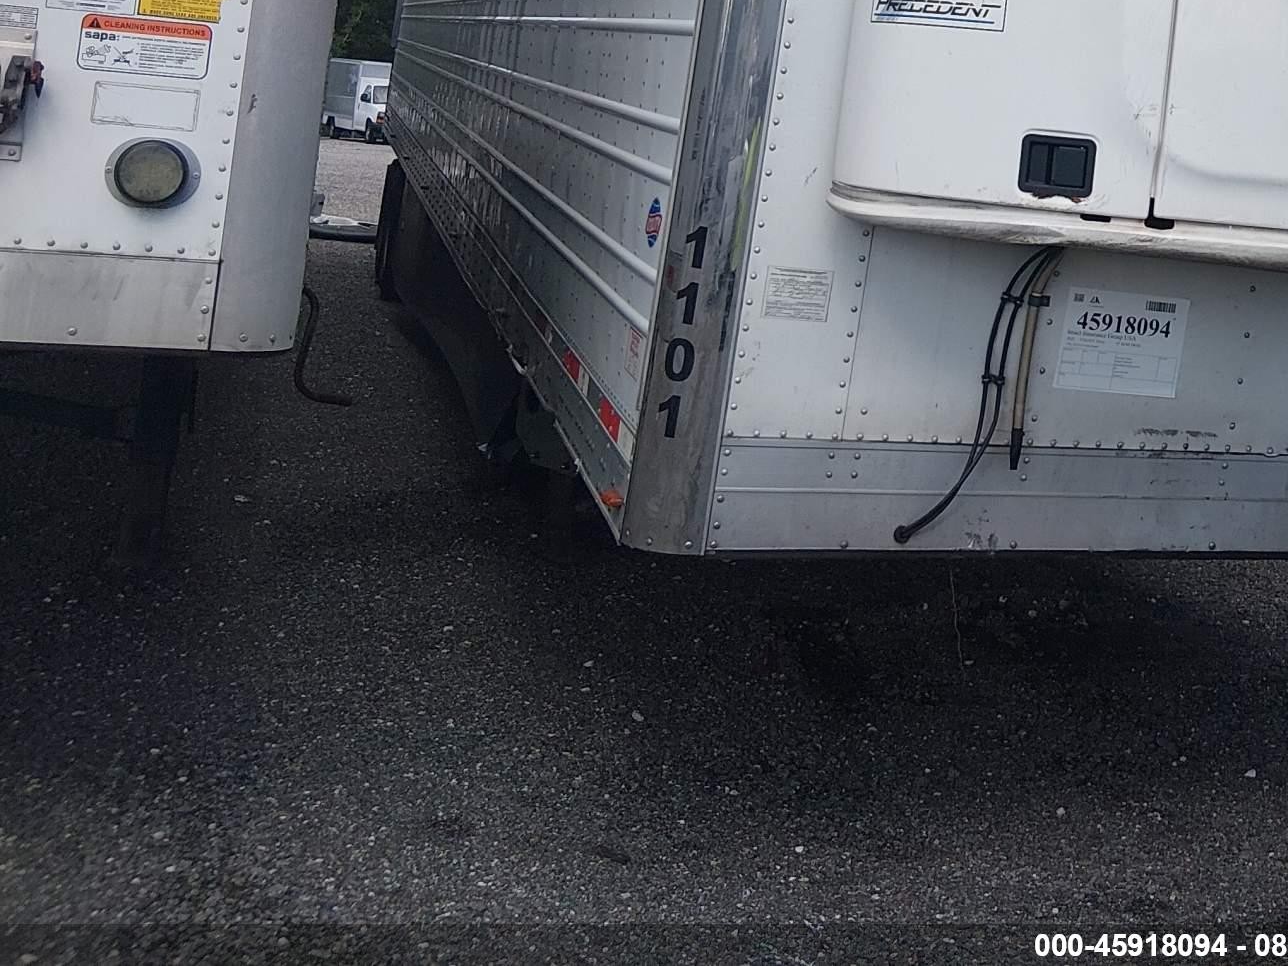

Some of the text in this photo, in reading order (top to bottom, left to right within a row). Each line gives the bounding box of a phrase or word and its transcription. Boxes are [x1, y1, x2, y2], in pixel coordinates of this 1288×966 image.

[103, 20, 206, 37] CLEANING INSTRUCTIONS
[658, 225, 709, 439] 1101
[1077, 311, 1172, 338] 45918094
